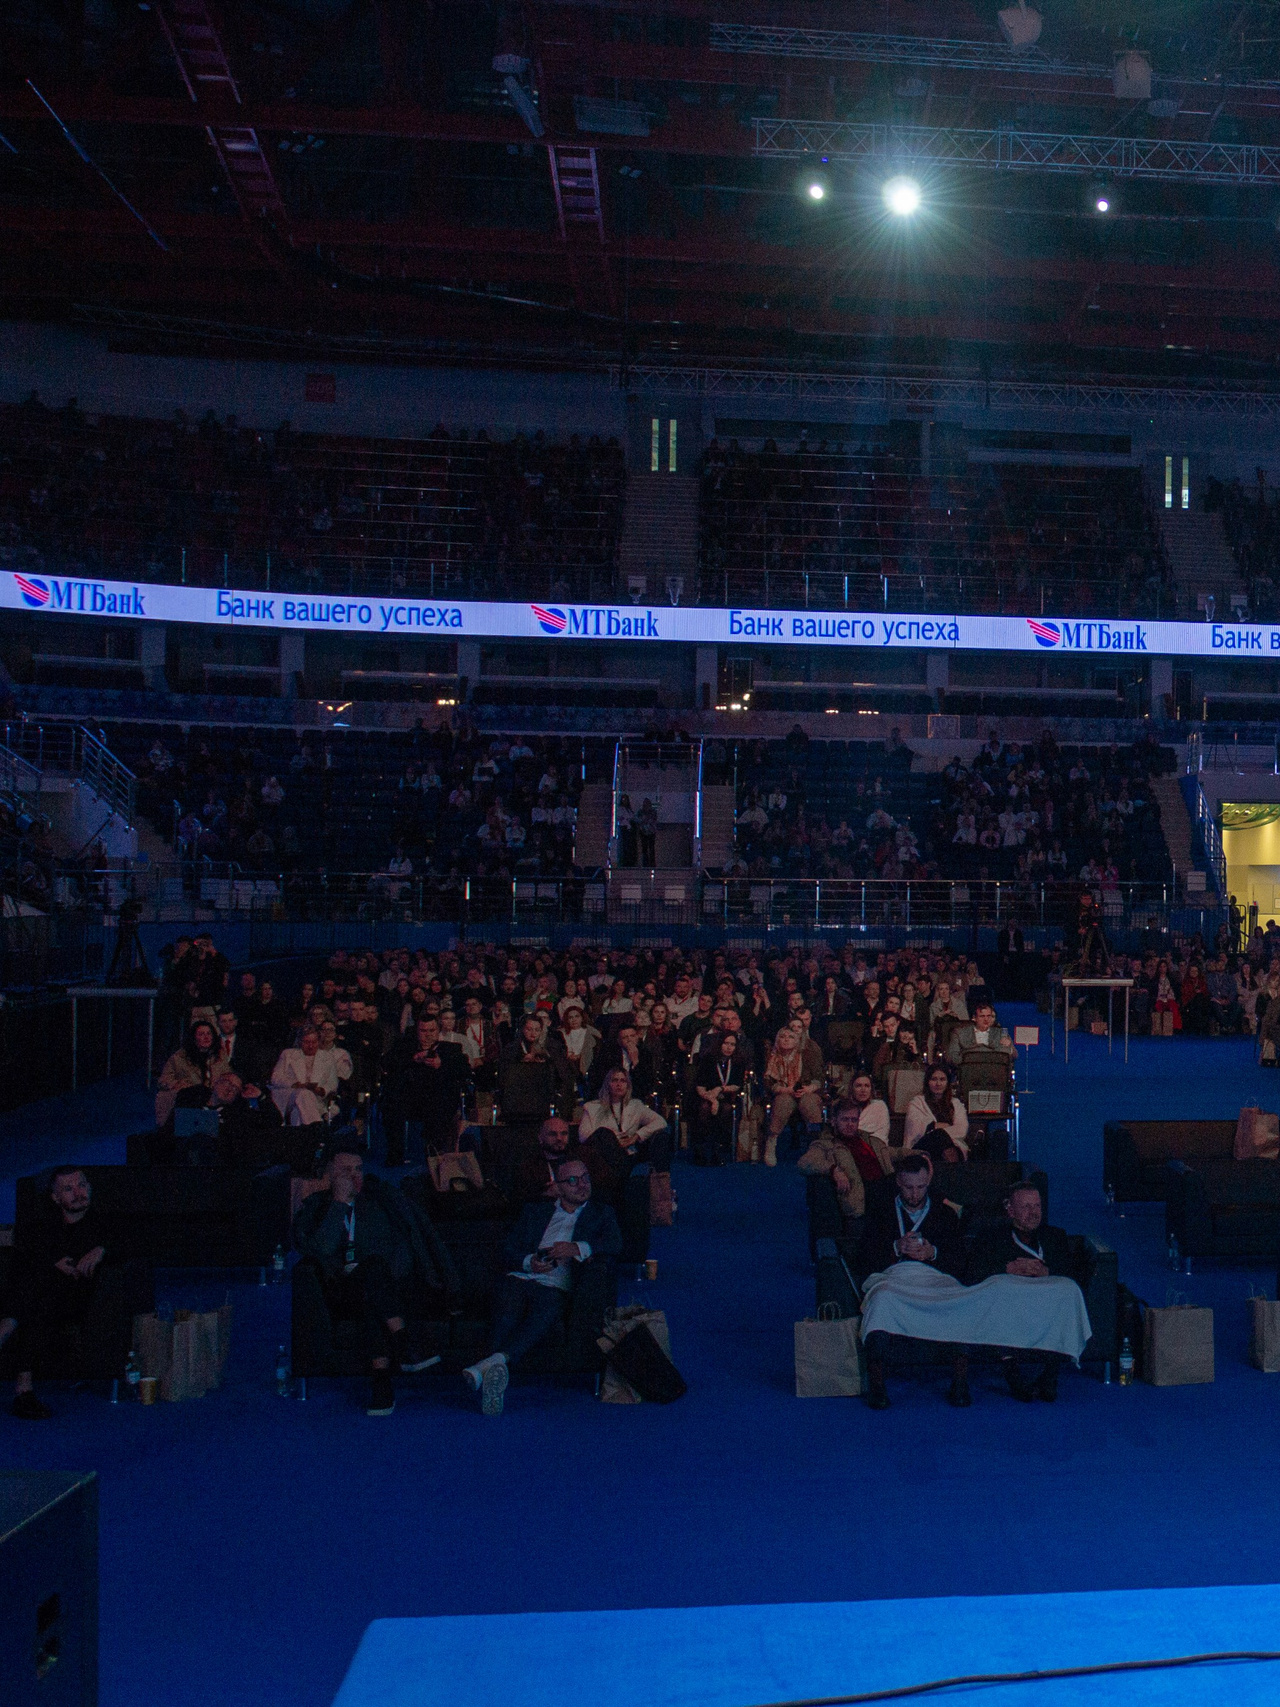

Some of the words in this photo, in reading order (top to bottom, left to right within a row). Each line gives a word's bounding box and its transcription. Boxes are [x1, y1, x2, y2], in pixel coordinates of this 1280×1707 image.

[50, 580, 146, 615] МТБанк
[216, 590, 274, 619] Банк
[283, 600, 371, 624] вашего
[380, 604, 463, 631] успеха
[568, 608, 659, 636] МТБанк
[729, 611, 783, 636] Банк
[792, 617, 875, 639] вашего
[882, 619, 959, 645] успеха
[1061, 622, 1147, 650] МТБанк
[1211, 625, 1262, 649] Банк
